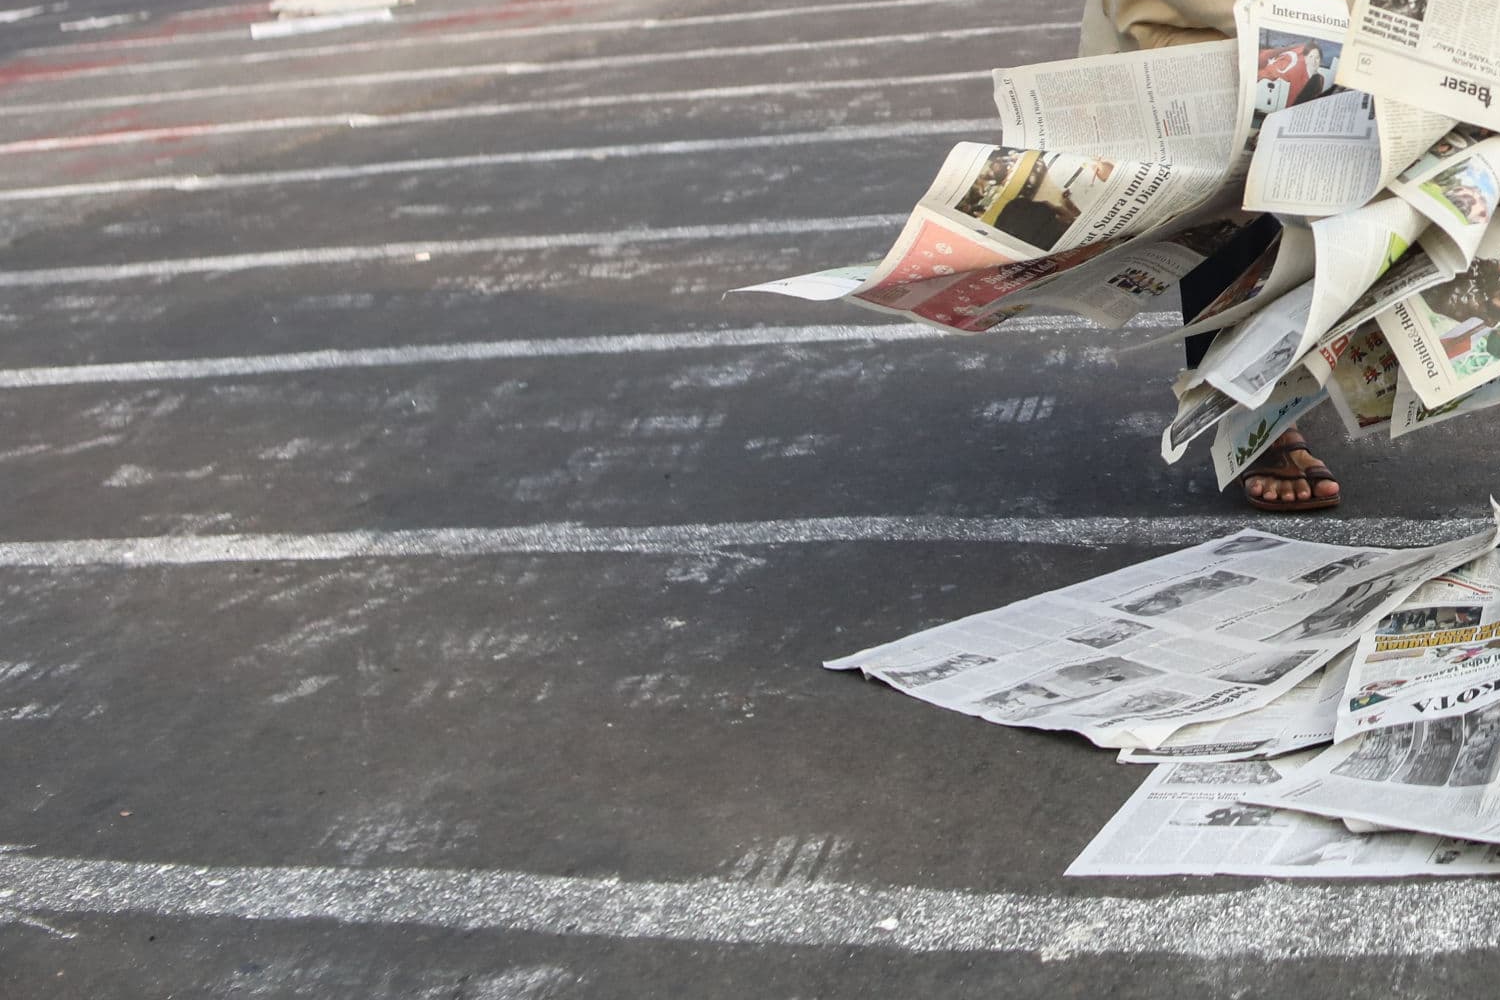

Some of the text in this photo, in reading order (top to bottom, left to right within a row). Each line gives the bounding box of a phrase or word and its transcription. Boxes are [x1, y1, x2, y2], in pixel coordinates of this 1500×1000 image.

[1271, 4, 1350, 28] Internasional
[1478, 64, 1498, 77] TIGA
[1008, 88, 1023, 126] Nusantara
[1092, 194, 1127, 234] Suara
[1119, 156, 1156, 198] untuk
[1459, 654, 1492, 670] Adha
